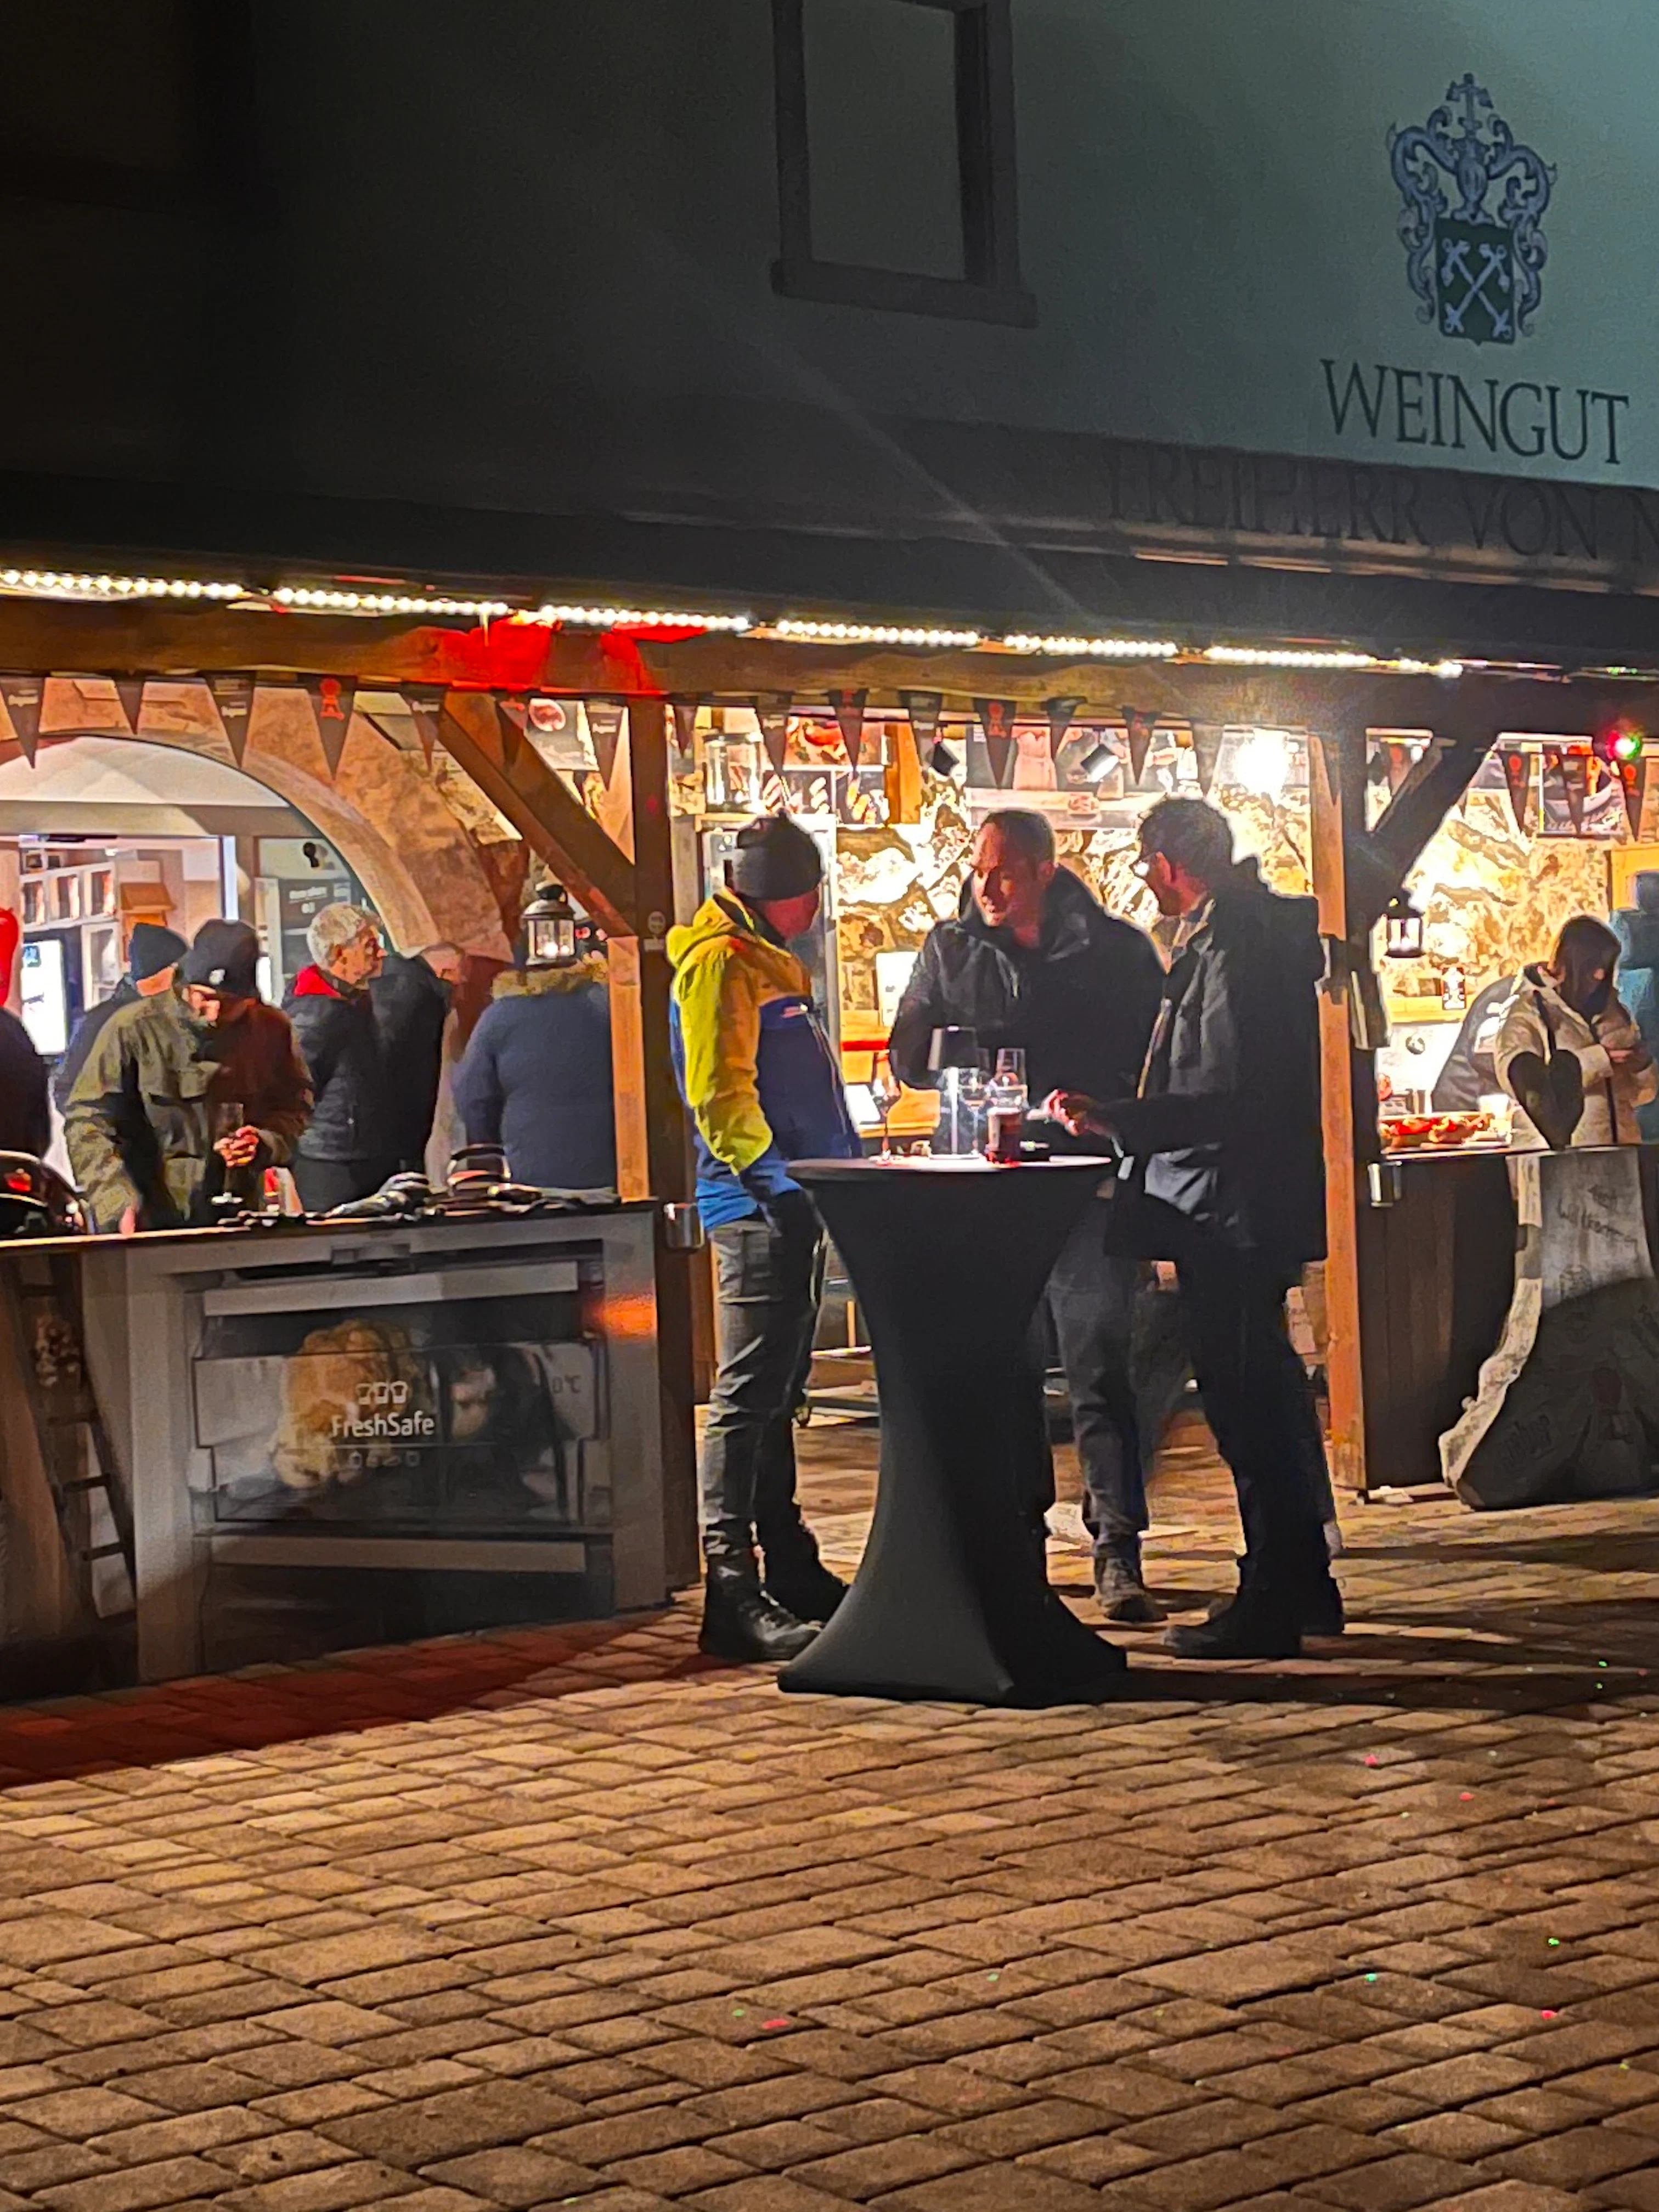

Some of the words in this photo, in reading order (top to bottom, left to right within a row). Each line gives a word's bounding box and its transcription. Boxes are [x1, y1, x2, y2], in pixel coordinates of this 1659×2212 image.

[1319, 358, 1629, 465] WEINGUT
[1455, 472, 1607, 561] VON
[331, 1410, 436, 1438] FreshSafe
